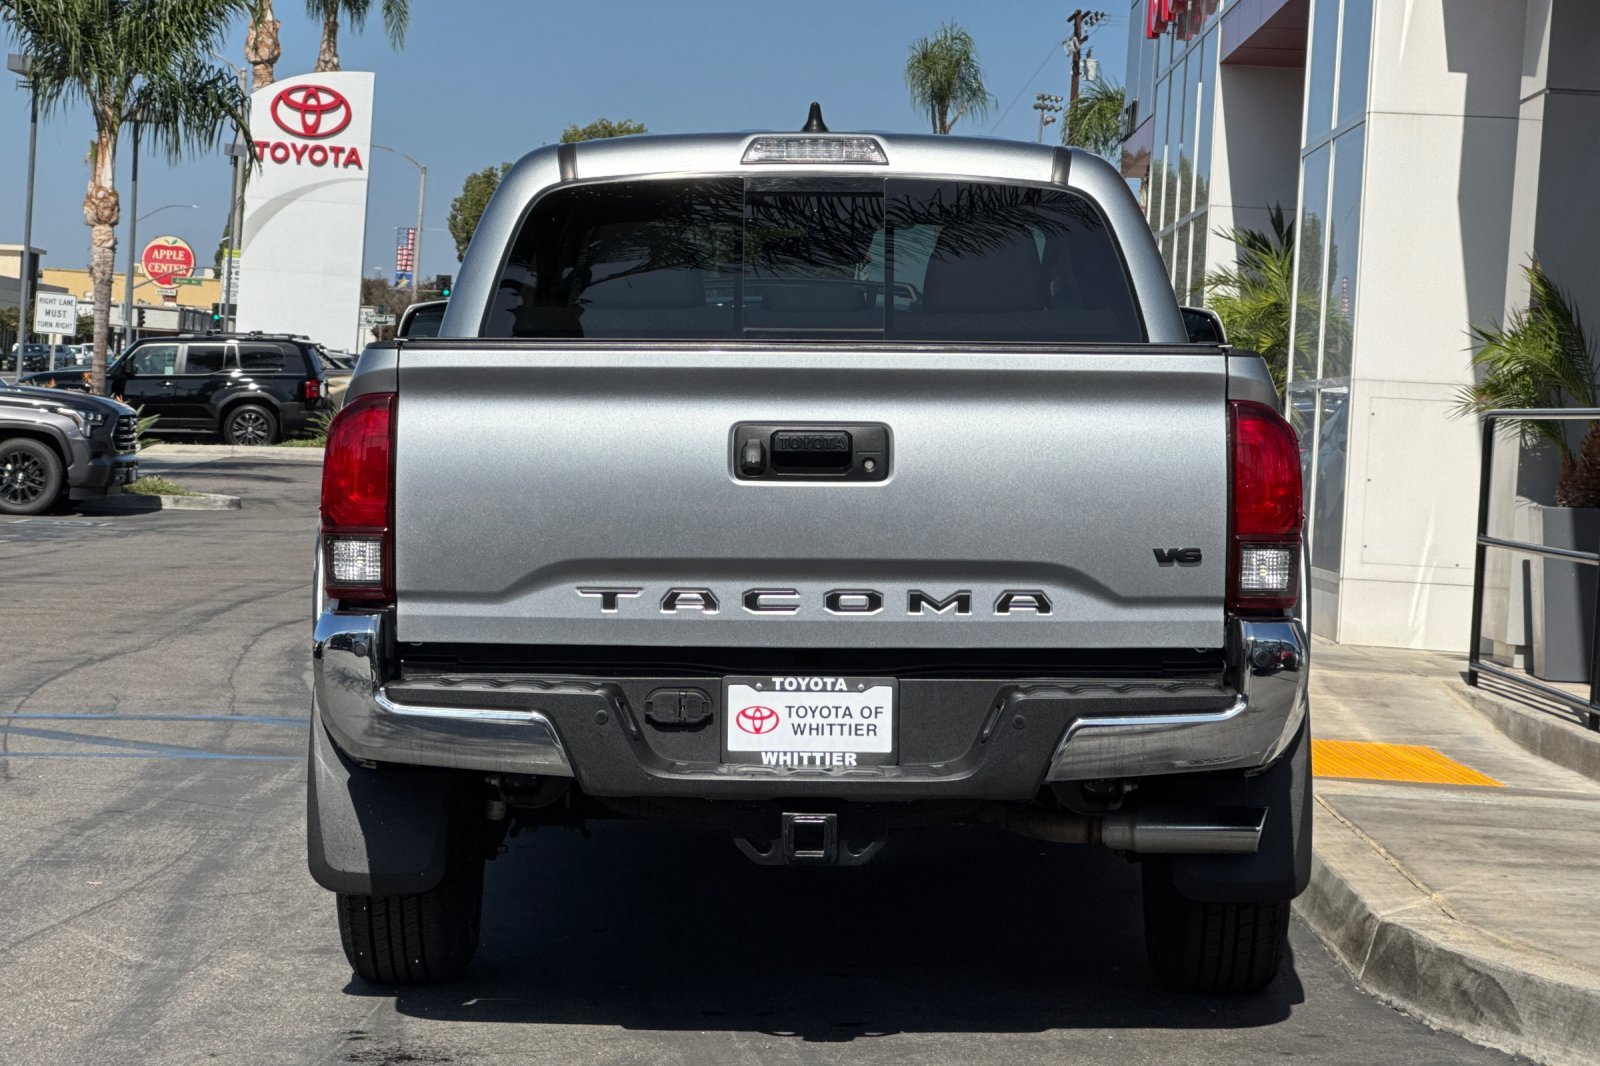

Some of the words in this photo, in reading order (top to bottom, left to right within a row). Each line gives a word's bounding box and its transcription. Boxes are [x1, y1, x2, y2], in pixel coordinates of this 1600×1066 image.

[254, 141, 363, 169] TOYOTA
[152, 249, 185, 261] APPLE
[148, 262, 187, 275] CENTER
[39, 297, 57, 305] RIGHT
[45, 309, 67, 318] MUST
[37, 320, 53, 328] TURN
[55, 321, 73, 330] RIGHT
[779, 436, 846, 450] TOYOTA
[1152, 547, 1202, 565] V6
[575, 586, 1054, 616] TACOMA
[772, 677, 848, 691] TOYOTA
[785, 705, 853, 719] TOYOTA
[860, 706, 885, 719] OF
[792, 723, 878, 737] WHITTIER
[761, 752, 857, 766] WHITTIER
